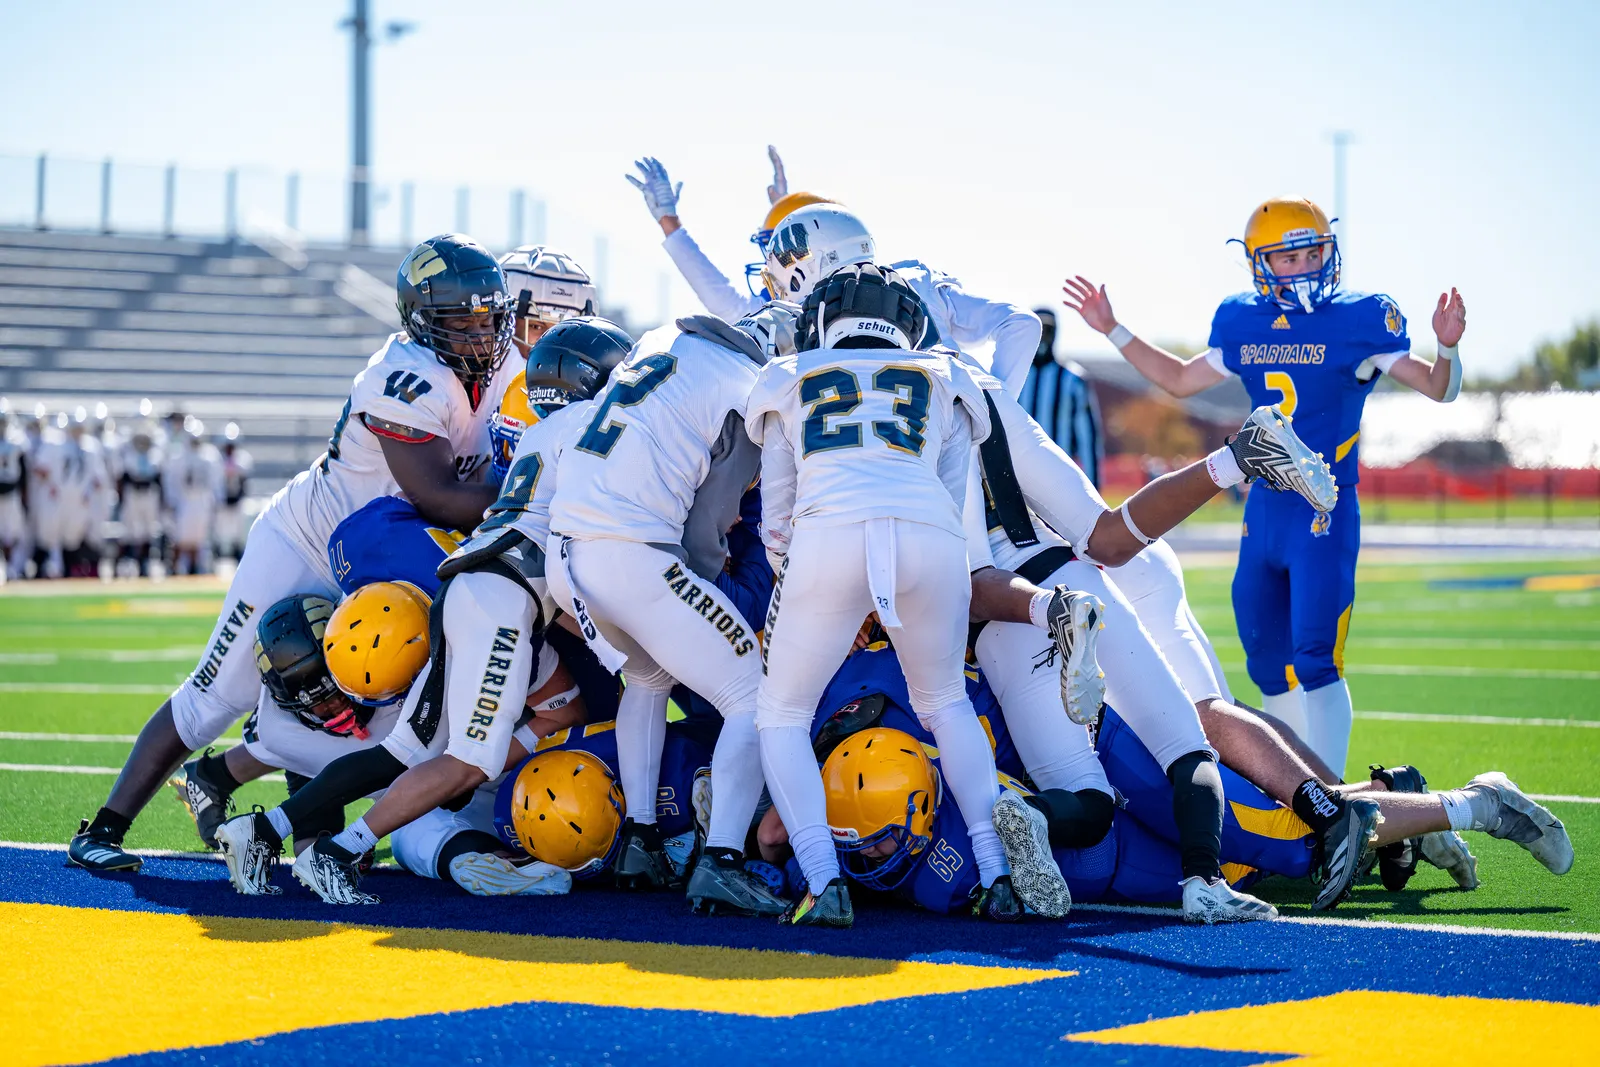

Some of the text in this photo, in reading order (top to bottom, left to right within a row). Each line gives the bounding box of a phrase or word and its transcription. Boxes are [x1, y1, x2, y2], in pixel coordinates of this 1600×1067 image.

[857, 321, 896, 336] schutt
[1240, 344, 1326, 365] SPARTANS
[529, 387, 557, 399] schutt
[573, 352, 679, 460] 2
[799, 365, 932, 460] 23
[662, 561, 755, 658] WARRIORS
[465, 625, 520, 743] WARRIORS
[1309, 787, 1339, 818] adidas
[927, 838, 964, 883] 65
